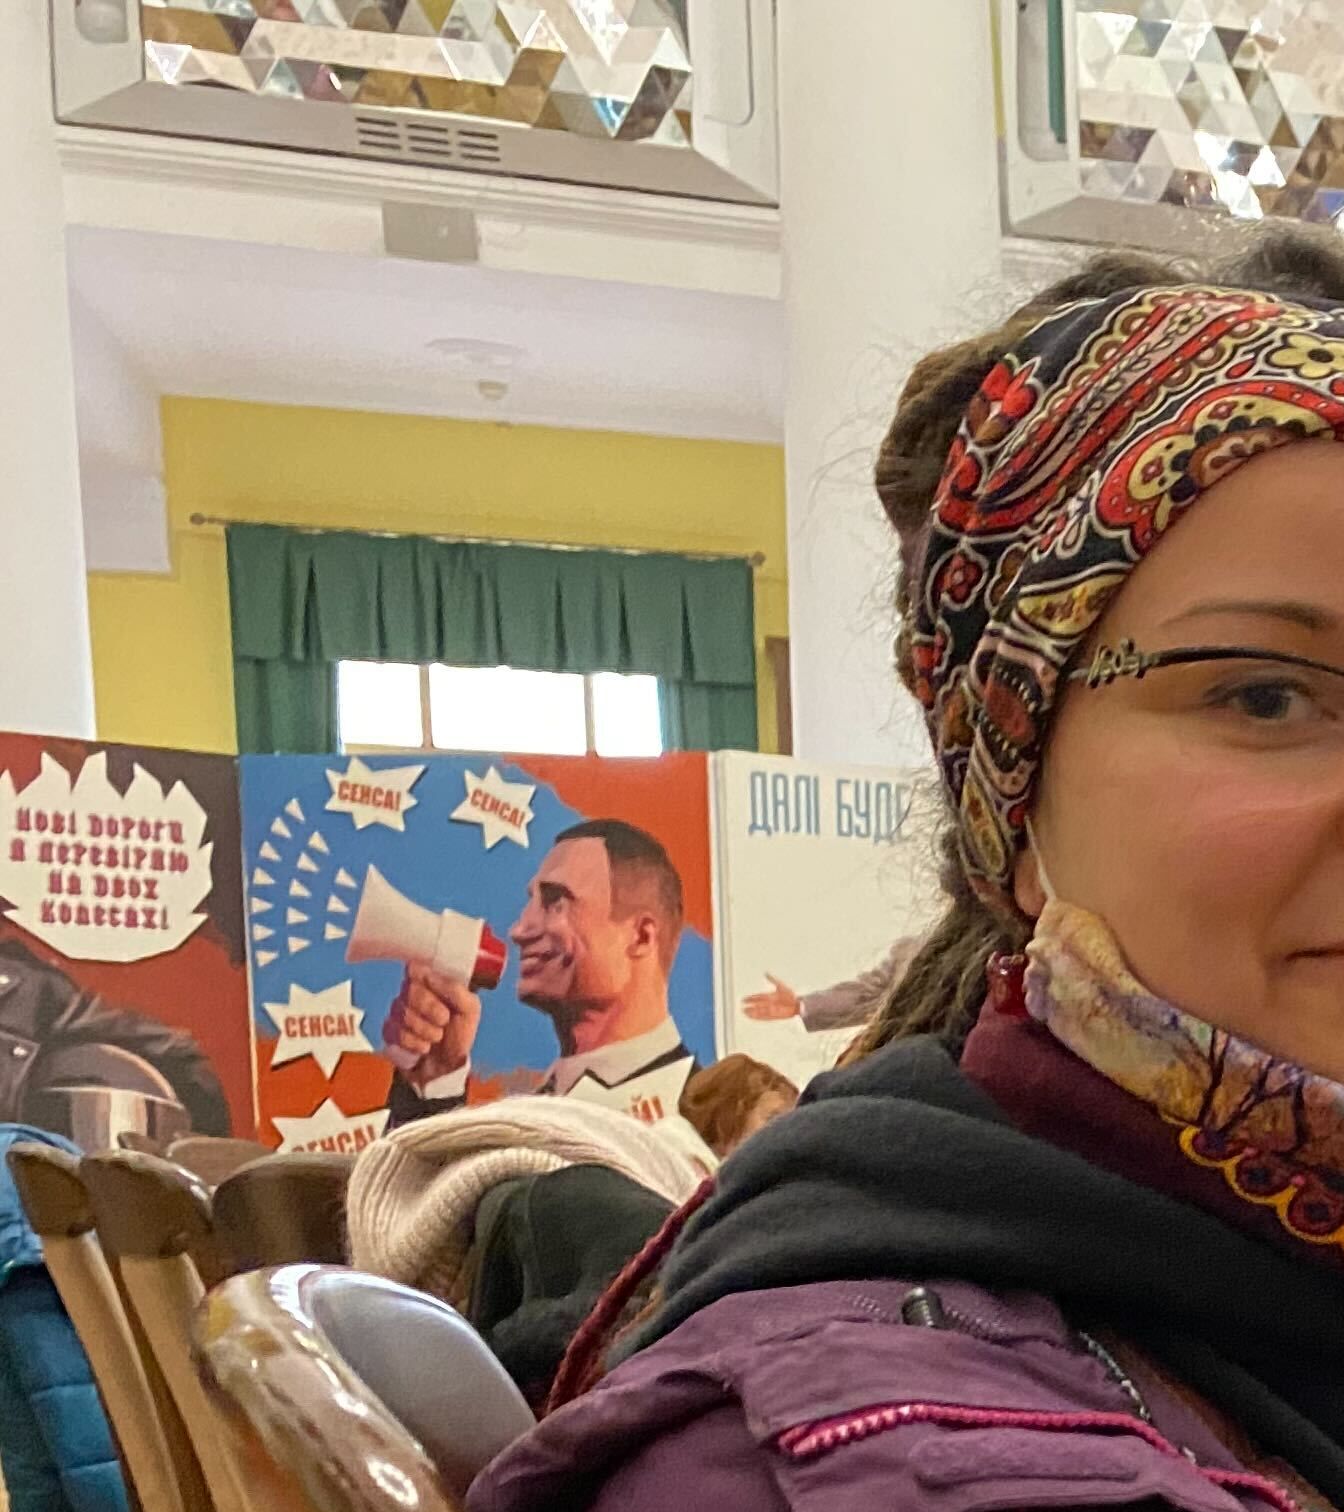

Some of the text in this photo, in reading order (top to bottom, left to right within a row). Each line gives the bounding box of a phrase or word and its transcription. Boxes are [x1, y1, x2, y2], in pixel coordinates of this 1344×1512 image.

[338, 780, 402, 812] СЕНСА!
[470, 788, 526, 830] СЕНСА!
[748, 771, 819, 836] ДАЛІ
[284, 1014, 355, 1038] СЕНСА!
